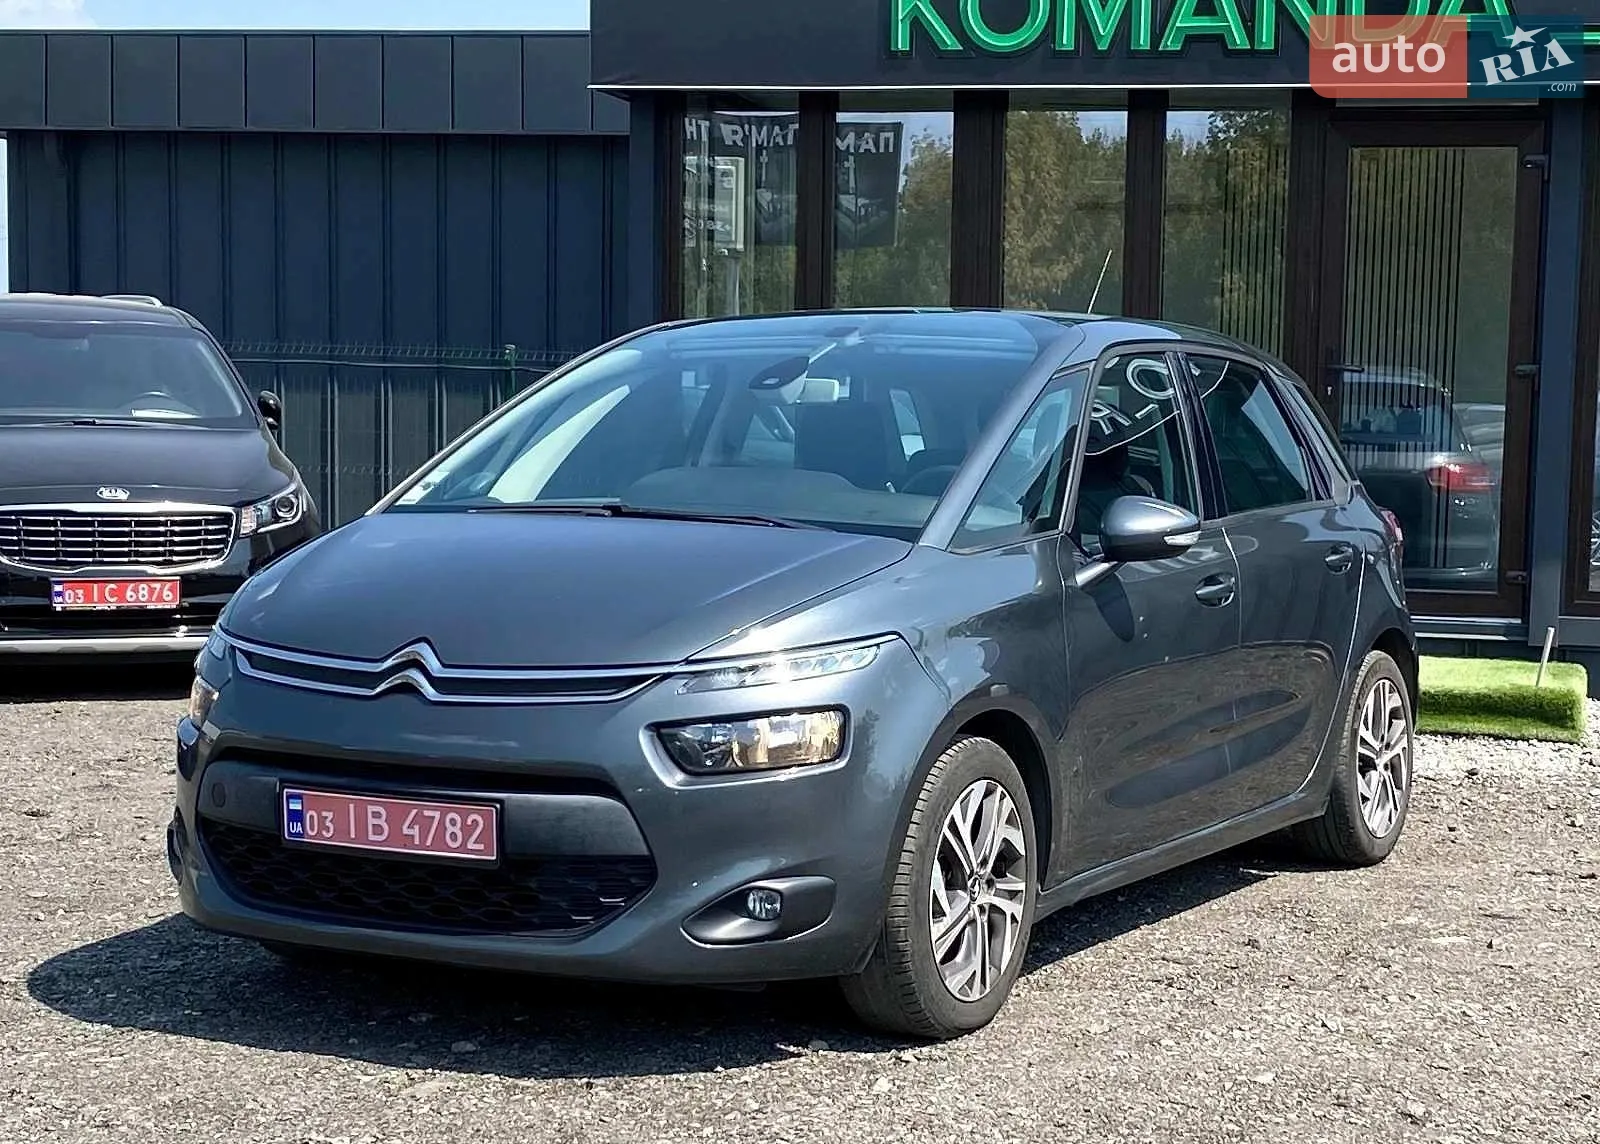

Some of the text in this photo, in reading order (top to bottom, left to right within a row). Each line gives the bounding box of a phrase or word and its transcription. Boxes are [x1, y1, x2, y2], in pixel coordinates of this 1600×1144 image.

[65, 590, 85, 604] 03
[93, 583, 119, 603] IC
[126, 583, 173, 602] 6876
[289, 803, 486, 851] UA 03 IB 4782
